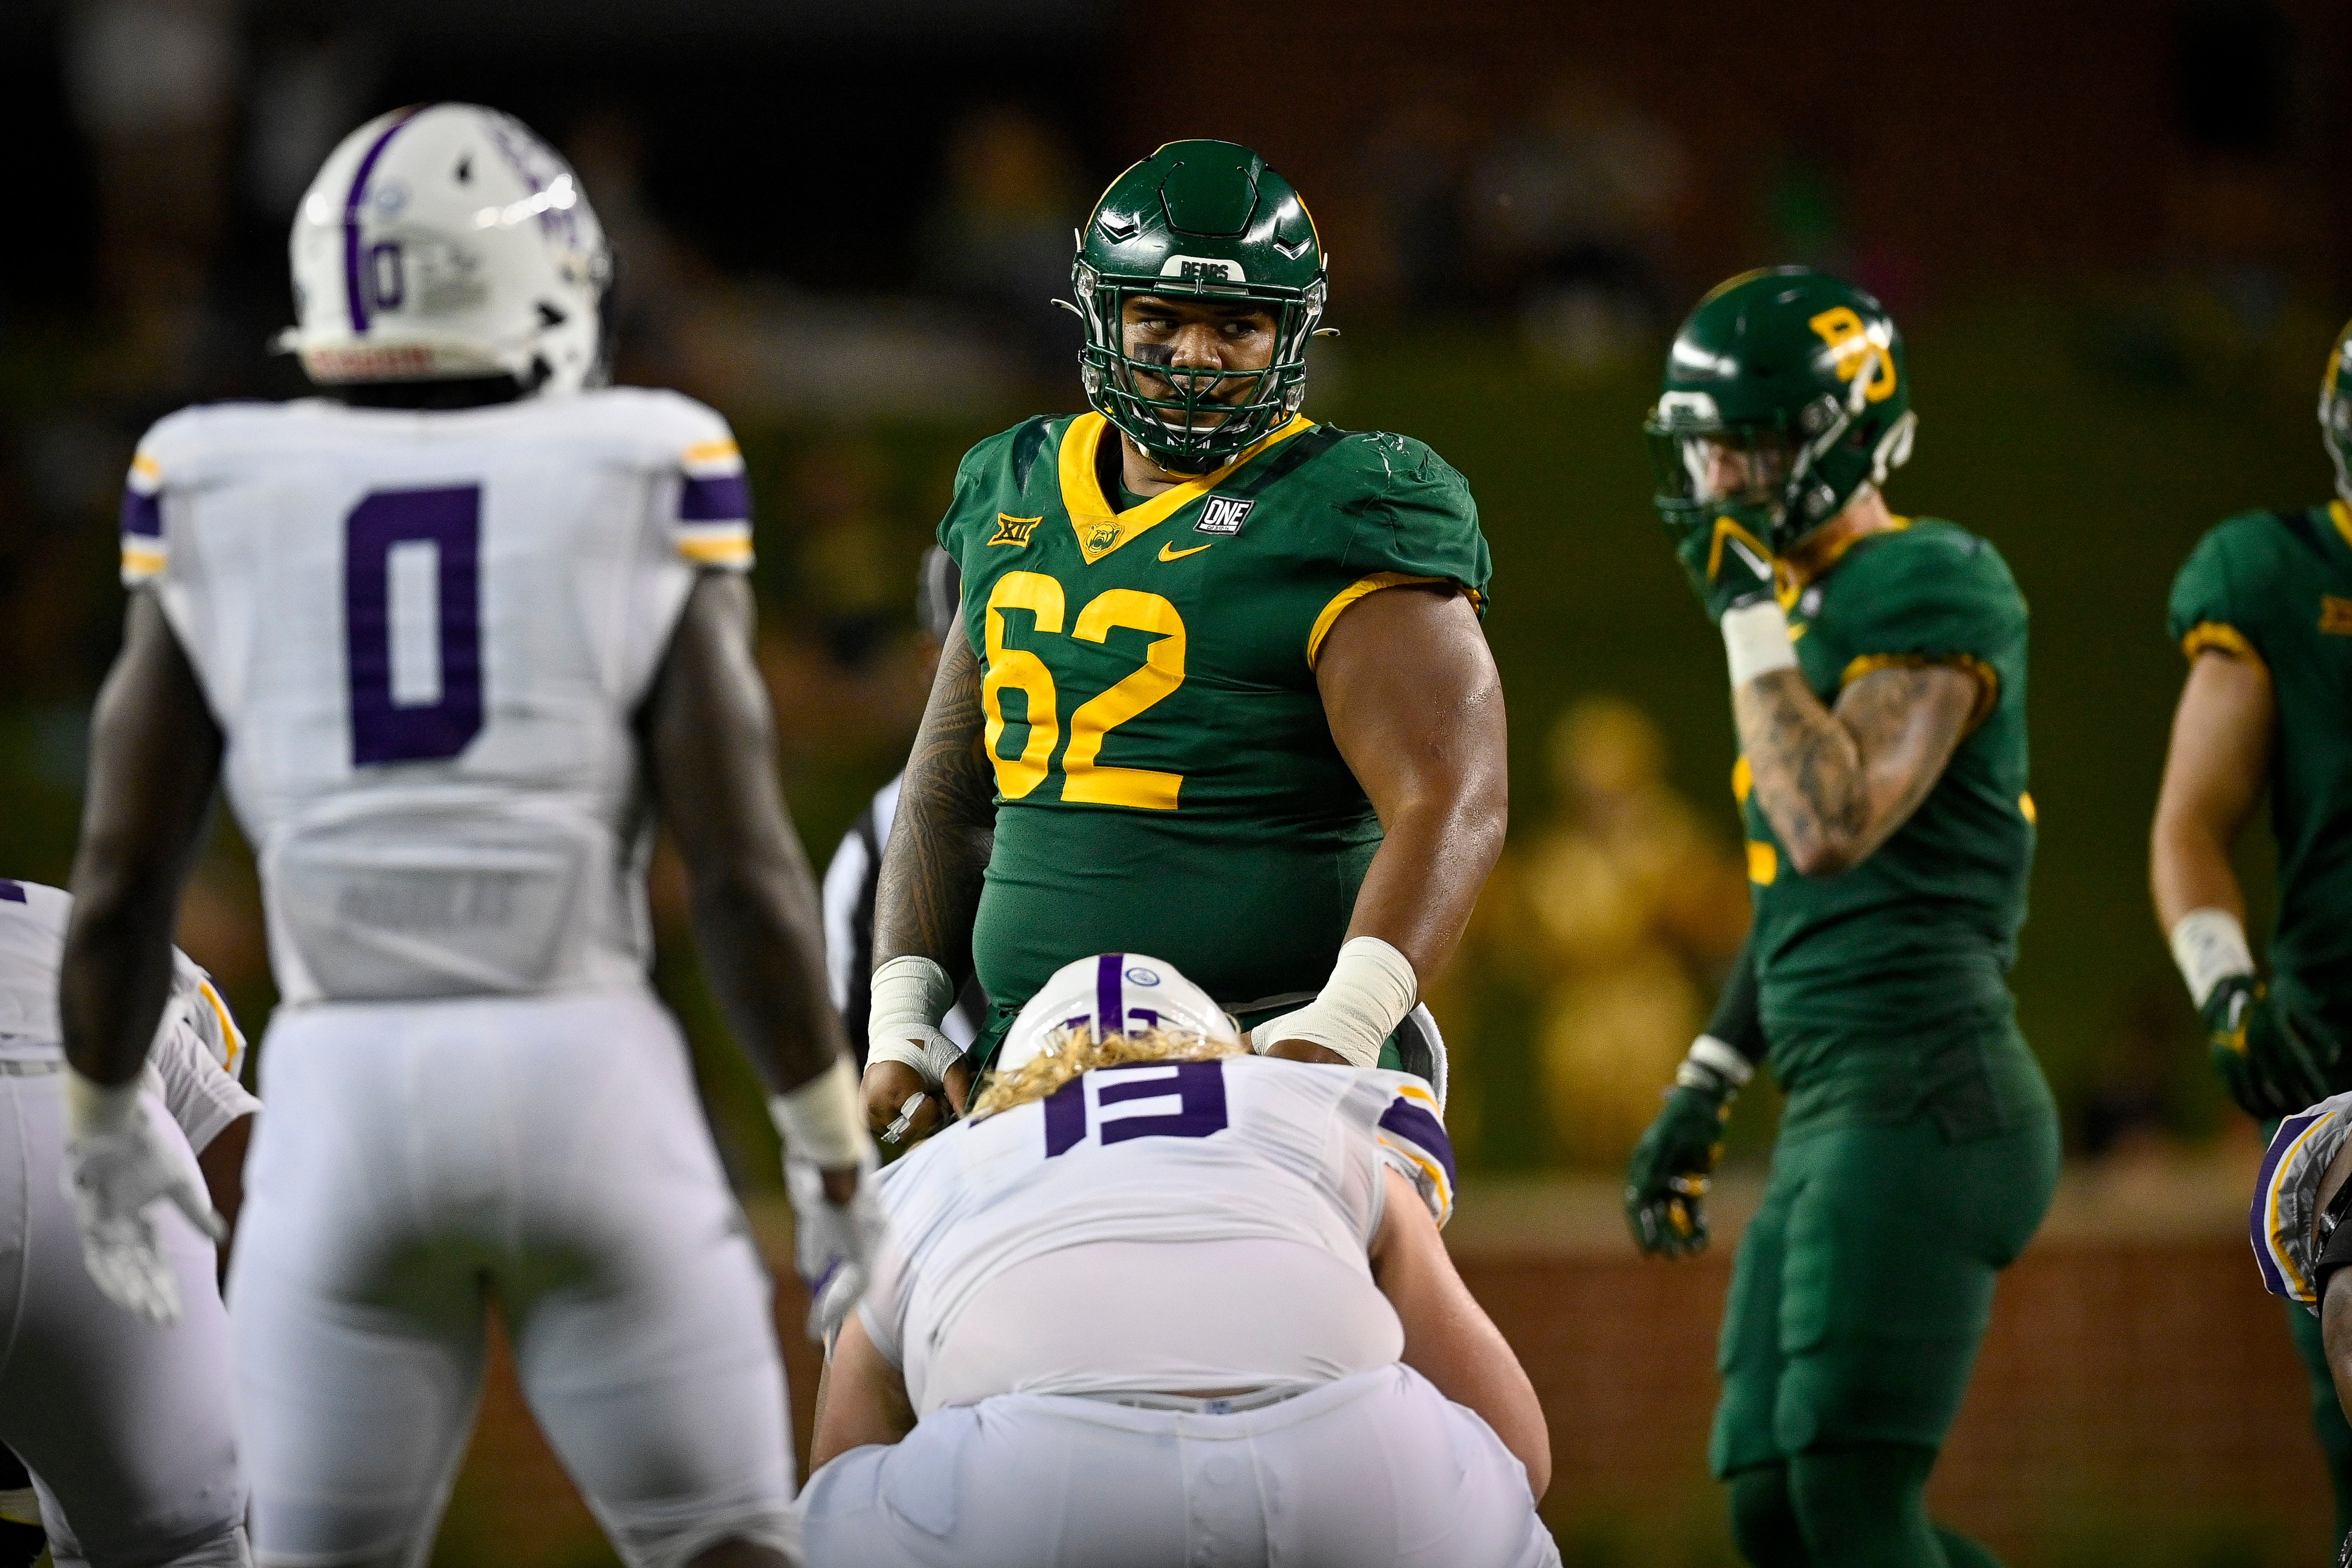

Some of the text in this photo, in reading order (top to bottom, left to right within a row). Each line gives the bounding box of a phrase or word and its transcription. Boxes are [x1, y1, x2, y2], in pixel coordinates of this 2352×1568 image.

[1180, 261, 1229, 280] BEARS
[1204, 499, 1249, 525] ONE
[991, 516, 1039, 544] XII
[346, 482, 484, 770] 0
[984, 571, 1186, 810] 62
